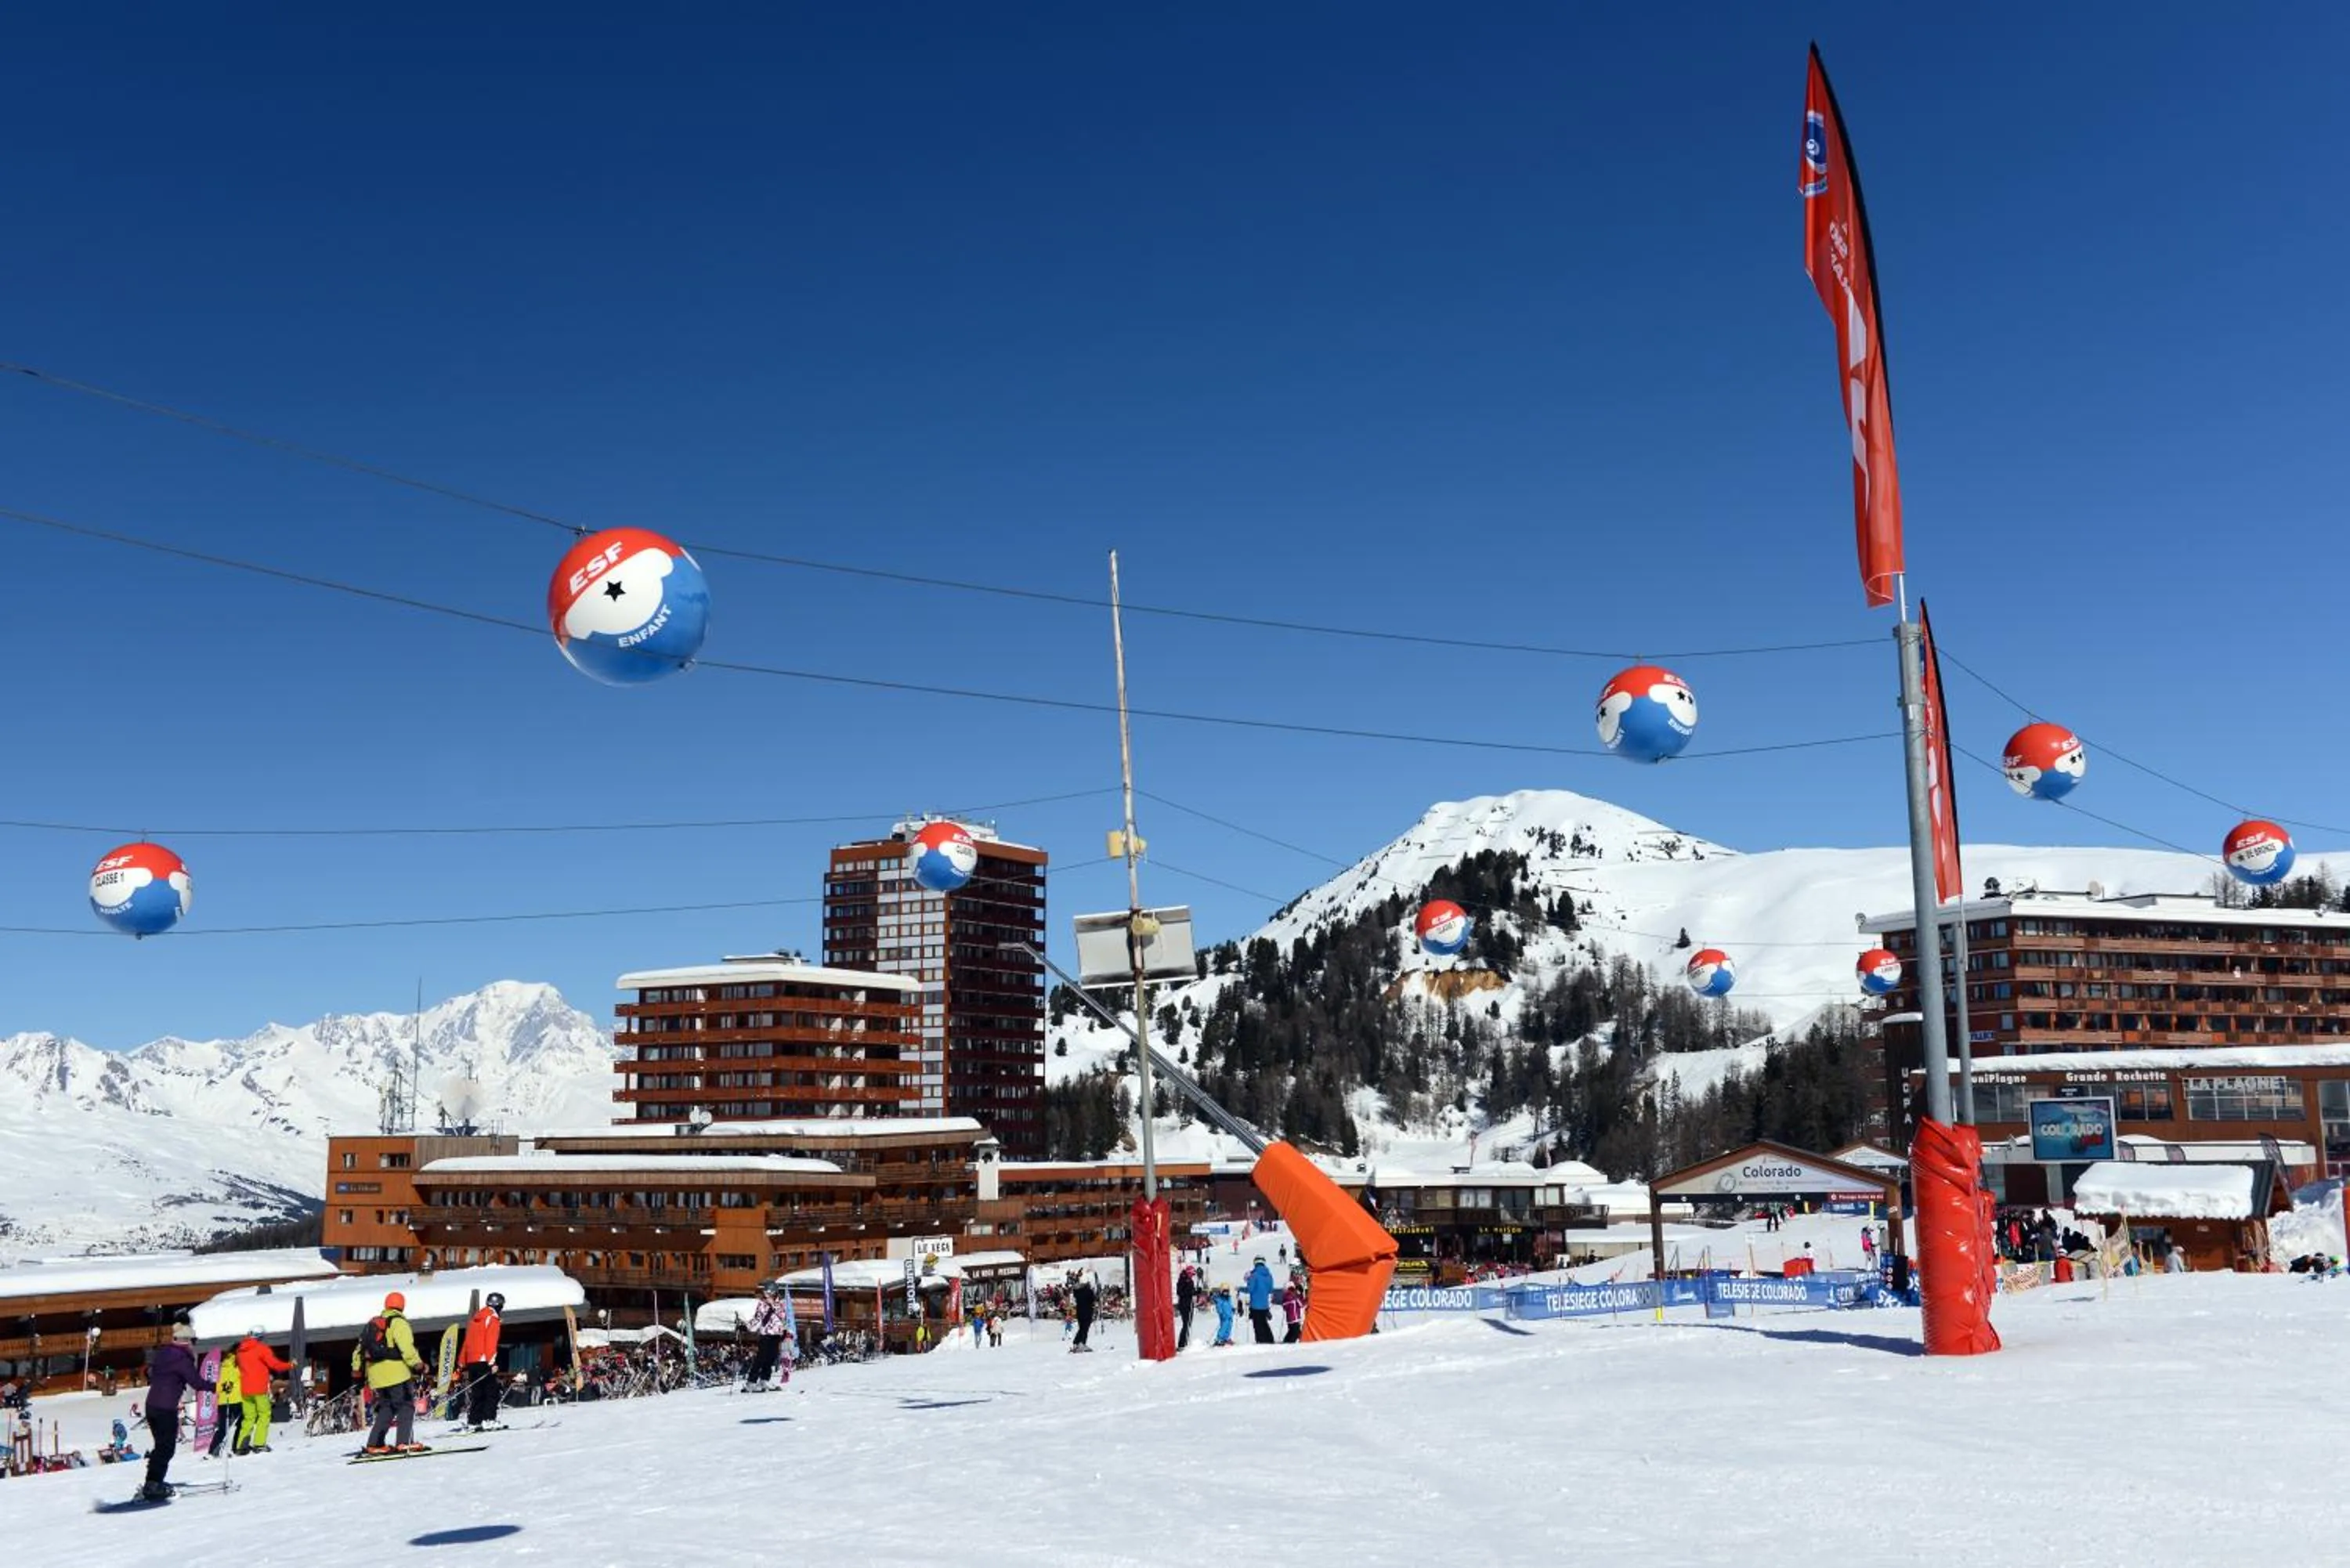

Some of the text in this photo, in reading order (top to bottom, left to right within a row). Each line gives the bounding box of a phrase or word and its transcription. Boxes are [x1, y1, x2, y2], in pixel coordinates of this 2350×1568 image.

[569, 541, 623, 595] ESF
[618, 604, 673, 649] ENFANT
[1971, 1073, 2027, 1085] uniPlagne
[2066, 1070, 2167, 1082] Grande Rochette
[2189, 1076, 2283, 1091] LA PLAGNE
[1901, 1068, 1913, 1124] UCPA
[2041, 1122, 2103, 1138] COLORADO
[1742, 1165, 1802, 1178] Colorado
[1409, 1289, 1472, 1308] COLORADO
[1546, 1292, 1596, 1313] TELESIEGE
[1598, 1288, 1651, 1307] COLORADO
[1762, 1284, 1808, 1301] COLORADO
